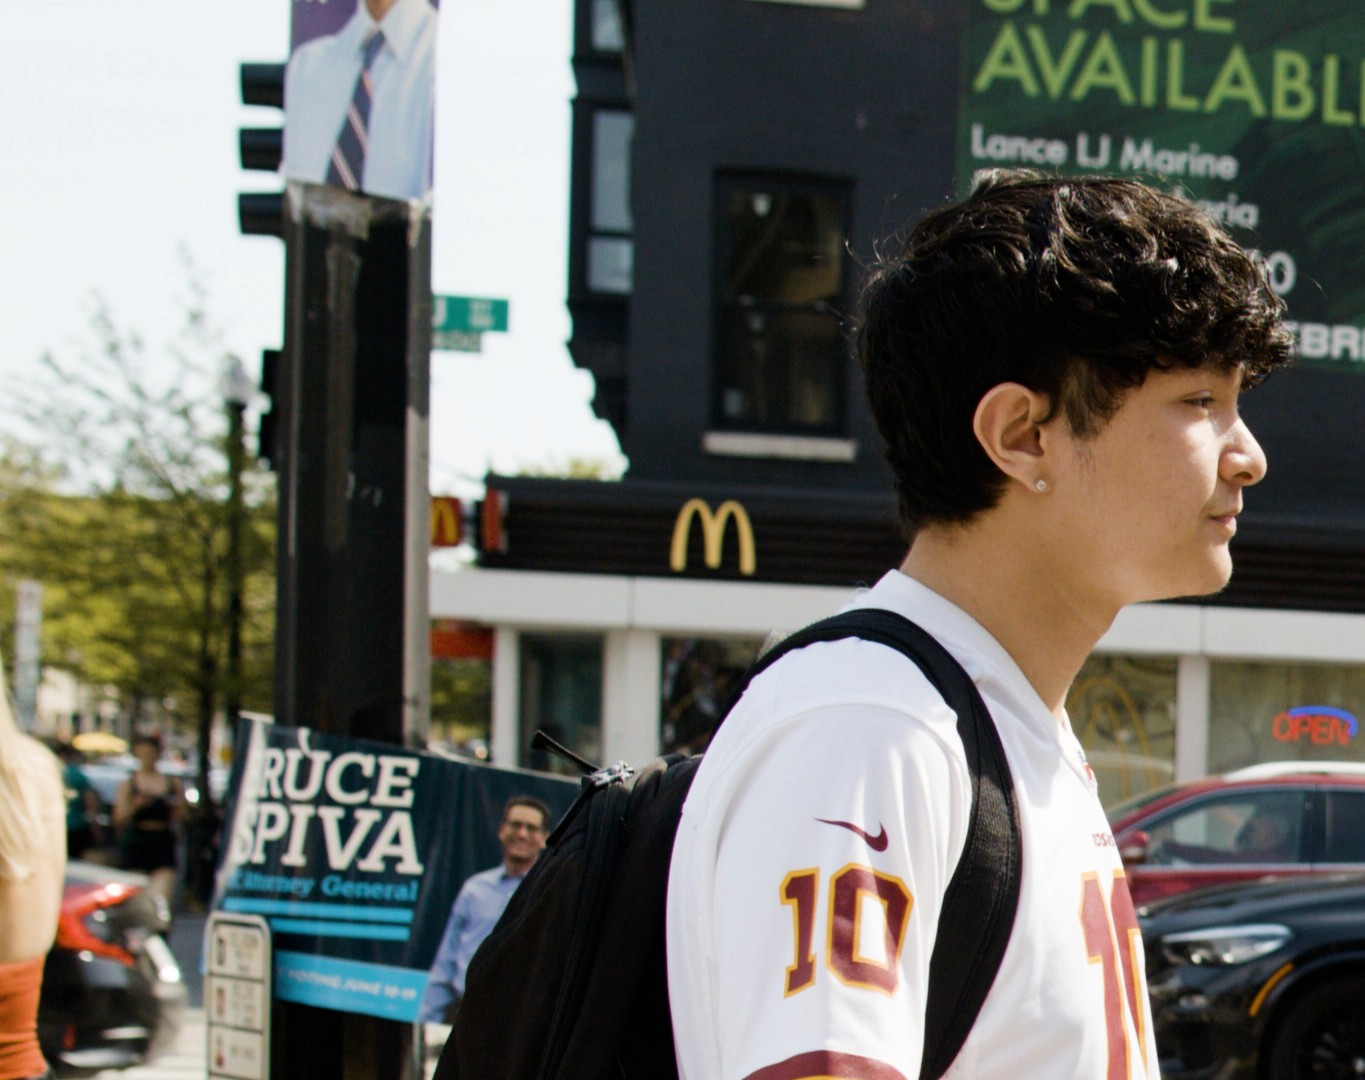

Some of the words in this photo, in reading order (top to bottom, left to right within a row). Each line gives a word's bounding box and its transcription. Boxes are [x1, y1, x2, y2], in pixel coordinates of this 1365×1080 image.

[971, 123, 1068, 166] Lance
[1119, 137, 1239, 181] Marine
[1272, 708, 1350, 746] OPEN
[244, 744, 421, 809] RUCE
[321, 874, 420, 901] General
[779, 861, 914, 999] 10
